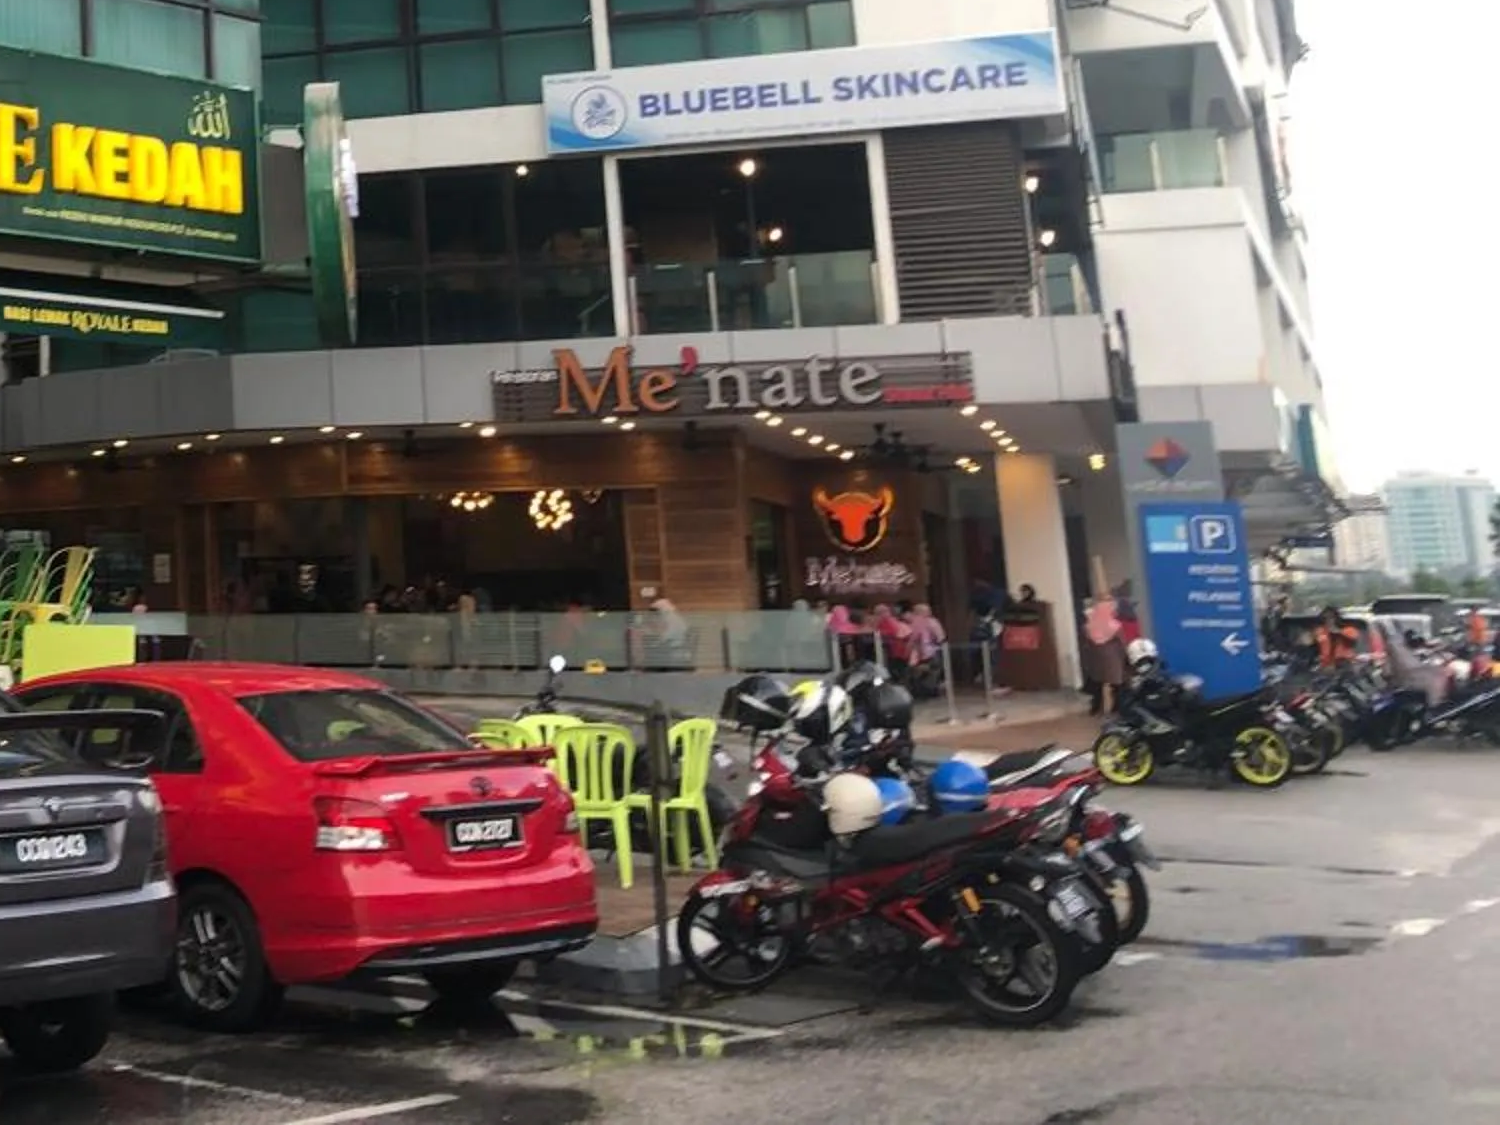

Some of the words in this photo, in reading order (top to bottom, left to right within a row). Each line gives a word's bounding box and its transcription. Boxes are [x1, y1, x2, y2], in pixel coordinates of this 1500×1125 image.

[638, 80, 822, 118] BLUEBELL
[831, 61, 1029, 103] SKINCARE
[52, 122, 244, 215] KEDAH
[71, 310, 132, 333] ROYALE
[552, 345, 883, 415] Me'nate
[1201, 521, 1225, 548] P
